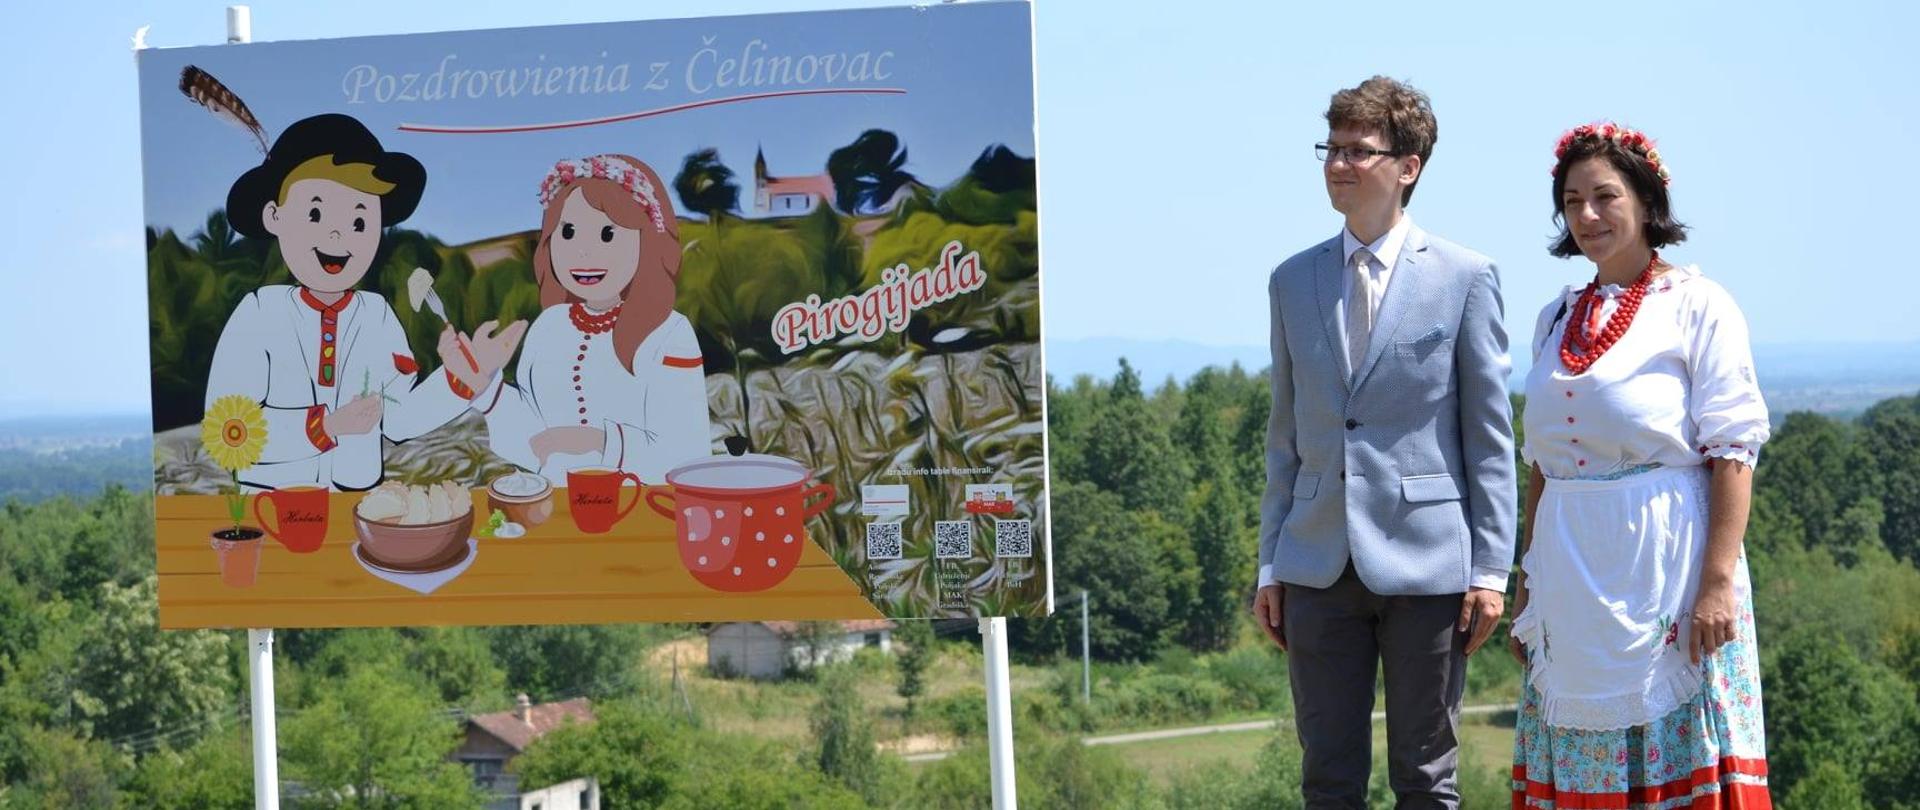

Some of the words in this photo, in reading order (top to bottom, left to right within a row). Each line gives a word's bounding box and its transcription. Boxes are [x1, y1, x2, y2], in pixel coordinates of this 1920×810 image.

[341, 51, 631, 104] Pozdrowienia
[643, 61, 671, 91] z
[685, 35, 895, 94] Čelinovac
[771, 240, 987, 355] Pirogijada
[913, 467, 929, 476] info
[930, 466, 949, 475] table
